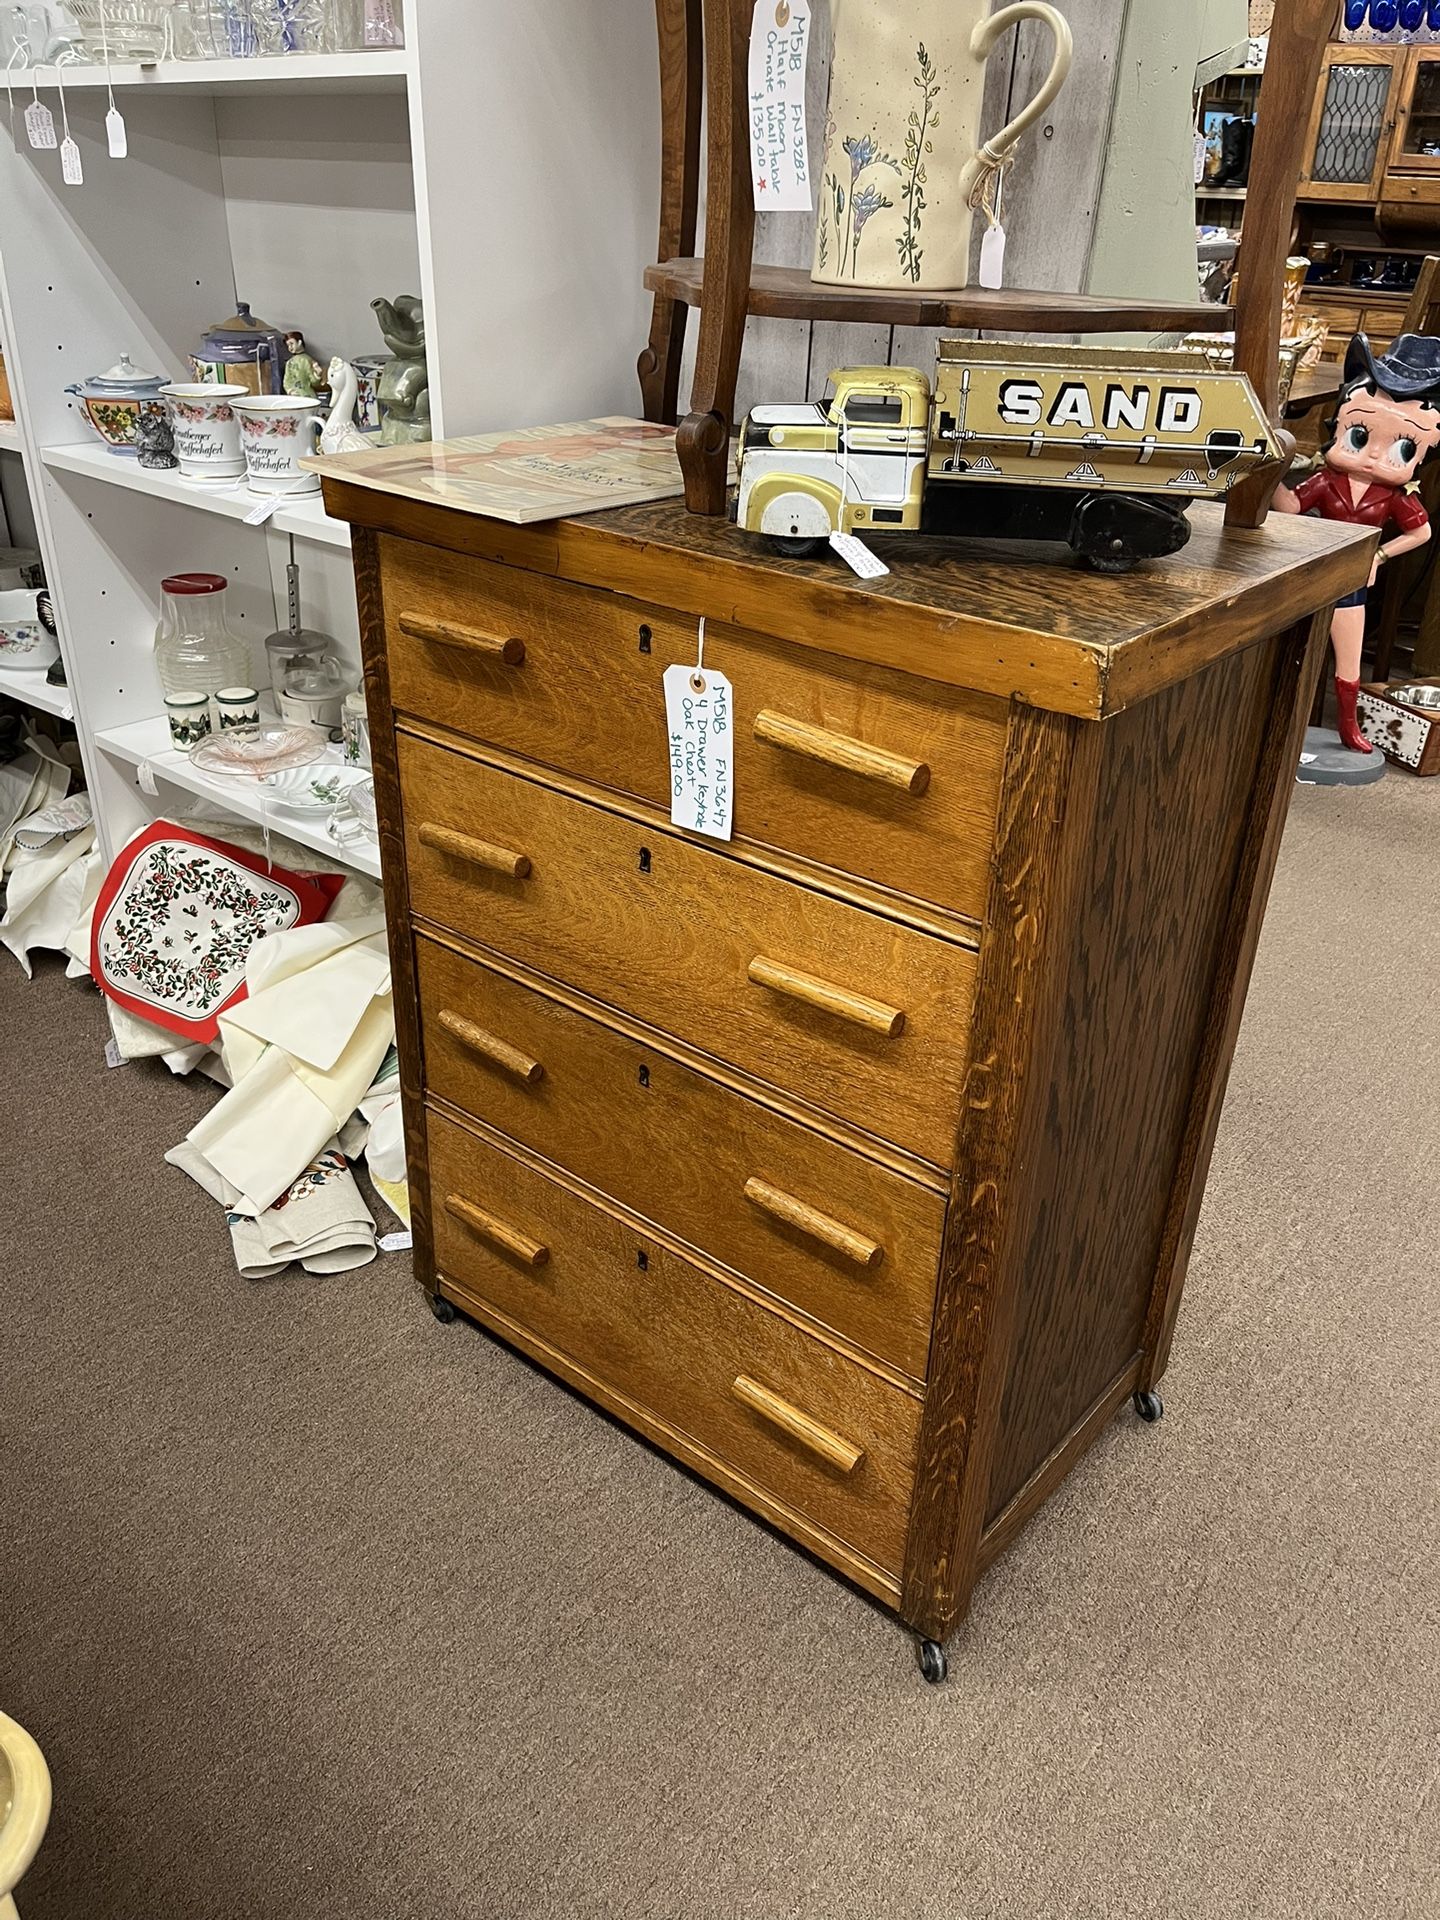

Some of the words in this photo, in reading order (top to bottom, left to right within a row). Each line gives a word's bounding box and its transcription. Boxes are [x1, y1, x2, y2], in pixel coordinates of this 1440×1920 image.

[766, 30, 777, 93] Ornate
[777, 40, 788, 89] Half
[789, 16, 806, 71] M518
[768, 151, 780, 194] table
[997, 379, 1202, 432] SAND
[695, 699, 708, 708] 4
[712, 686, 727, 735] M518
[671, 731, 683, 797] $149.00
[697, 718, 708, 778] Drawer
